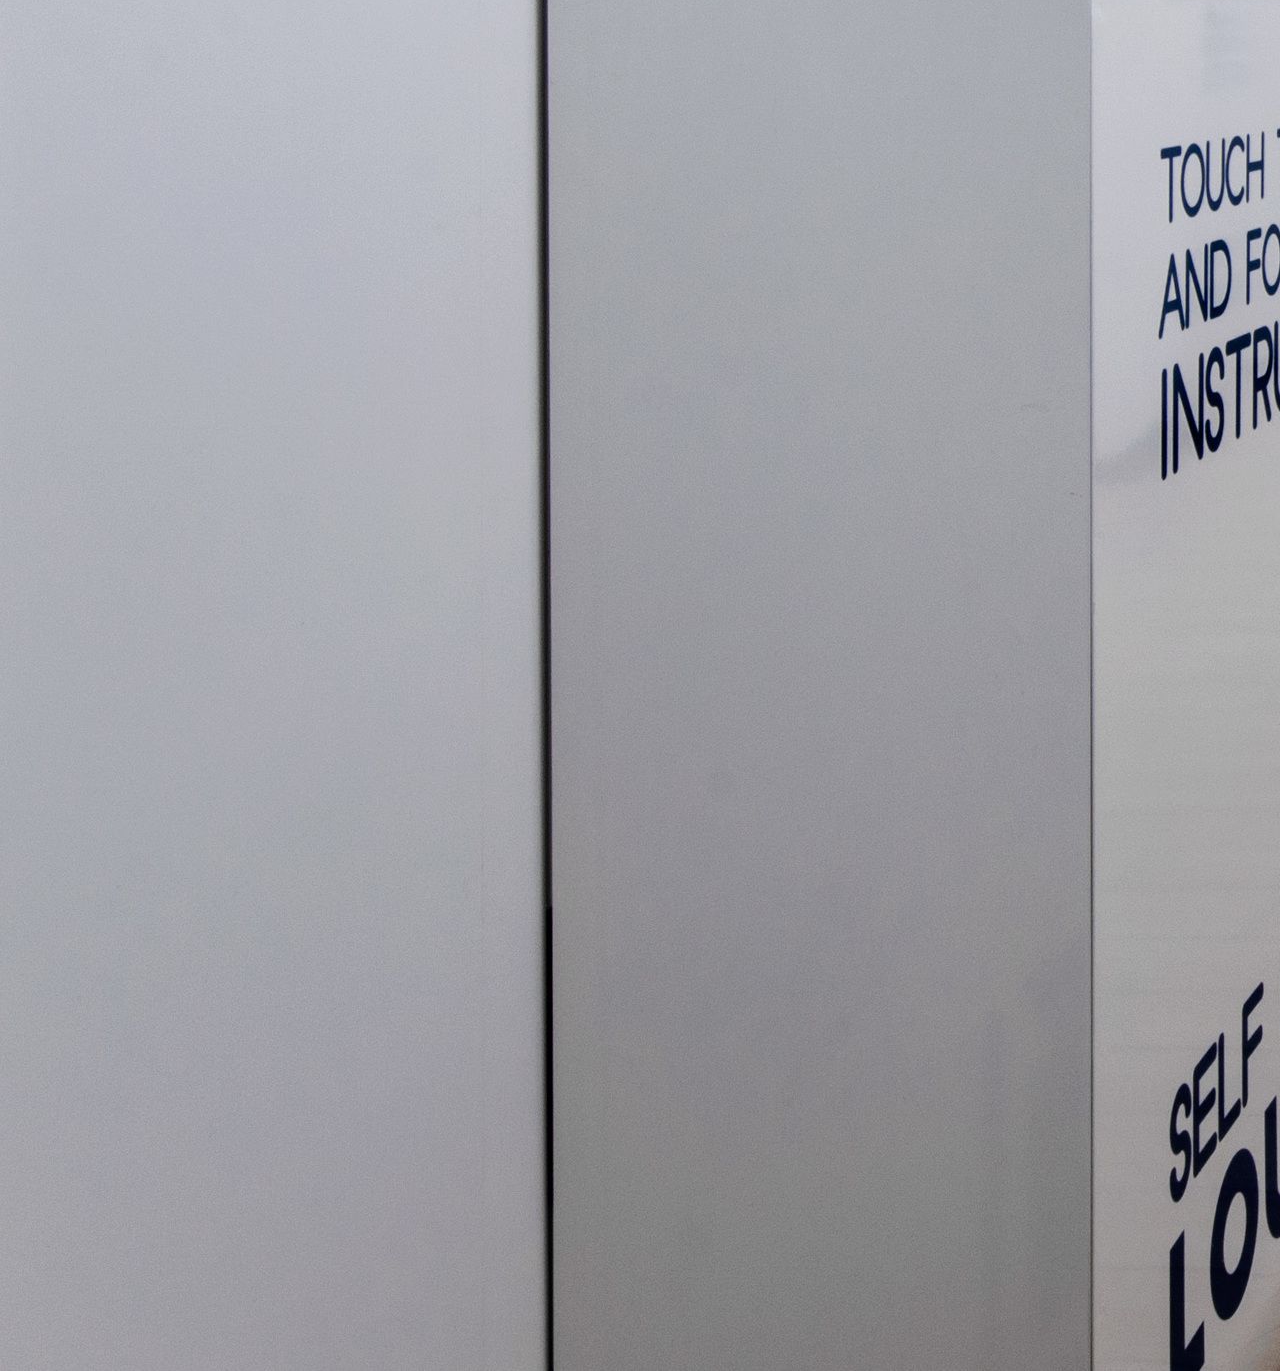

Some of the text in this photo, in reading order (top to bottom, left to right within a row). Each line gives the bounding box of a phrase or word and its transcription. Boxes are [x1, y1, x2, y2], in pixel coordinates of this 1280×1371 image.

[1161, 131, 1265, 223] TOUCH
[1158, 239, 1232, 340] AND
[1169, 981, 1265, 1204] SELF
